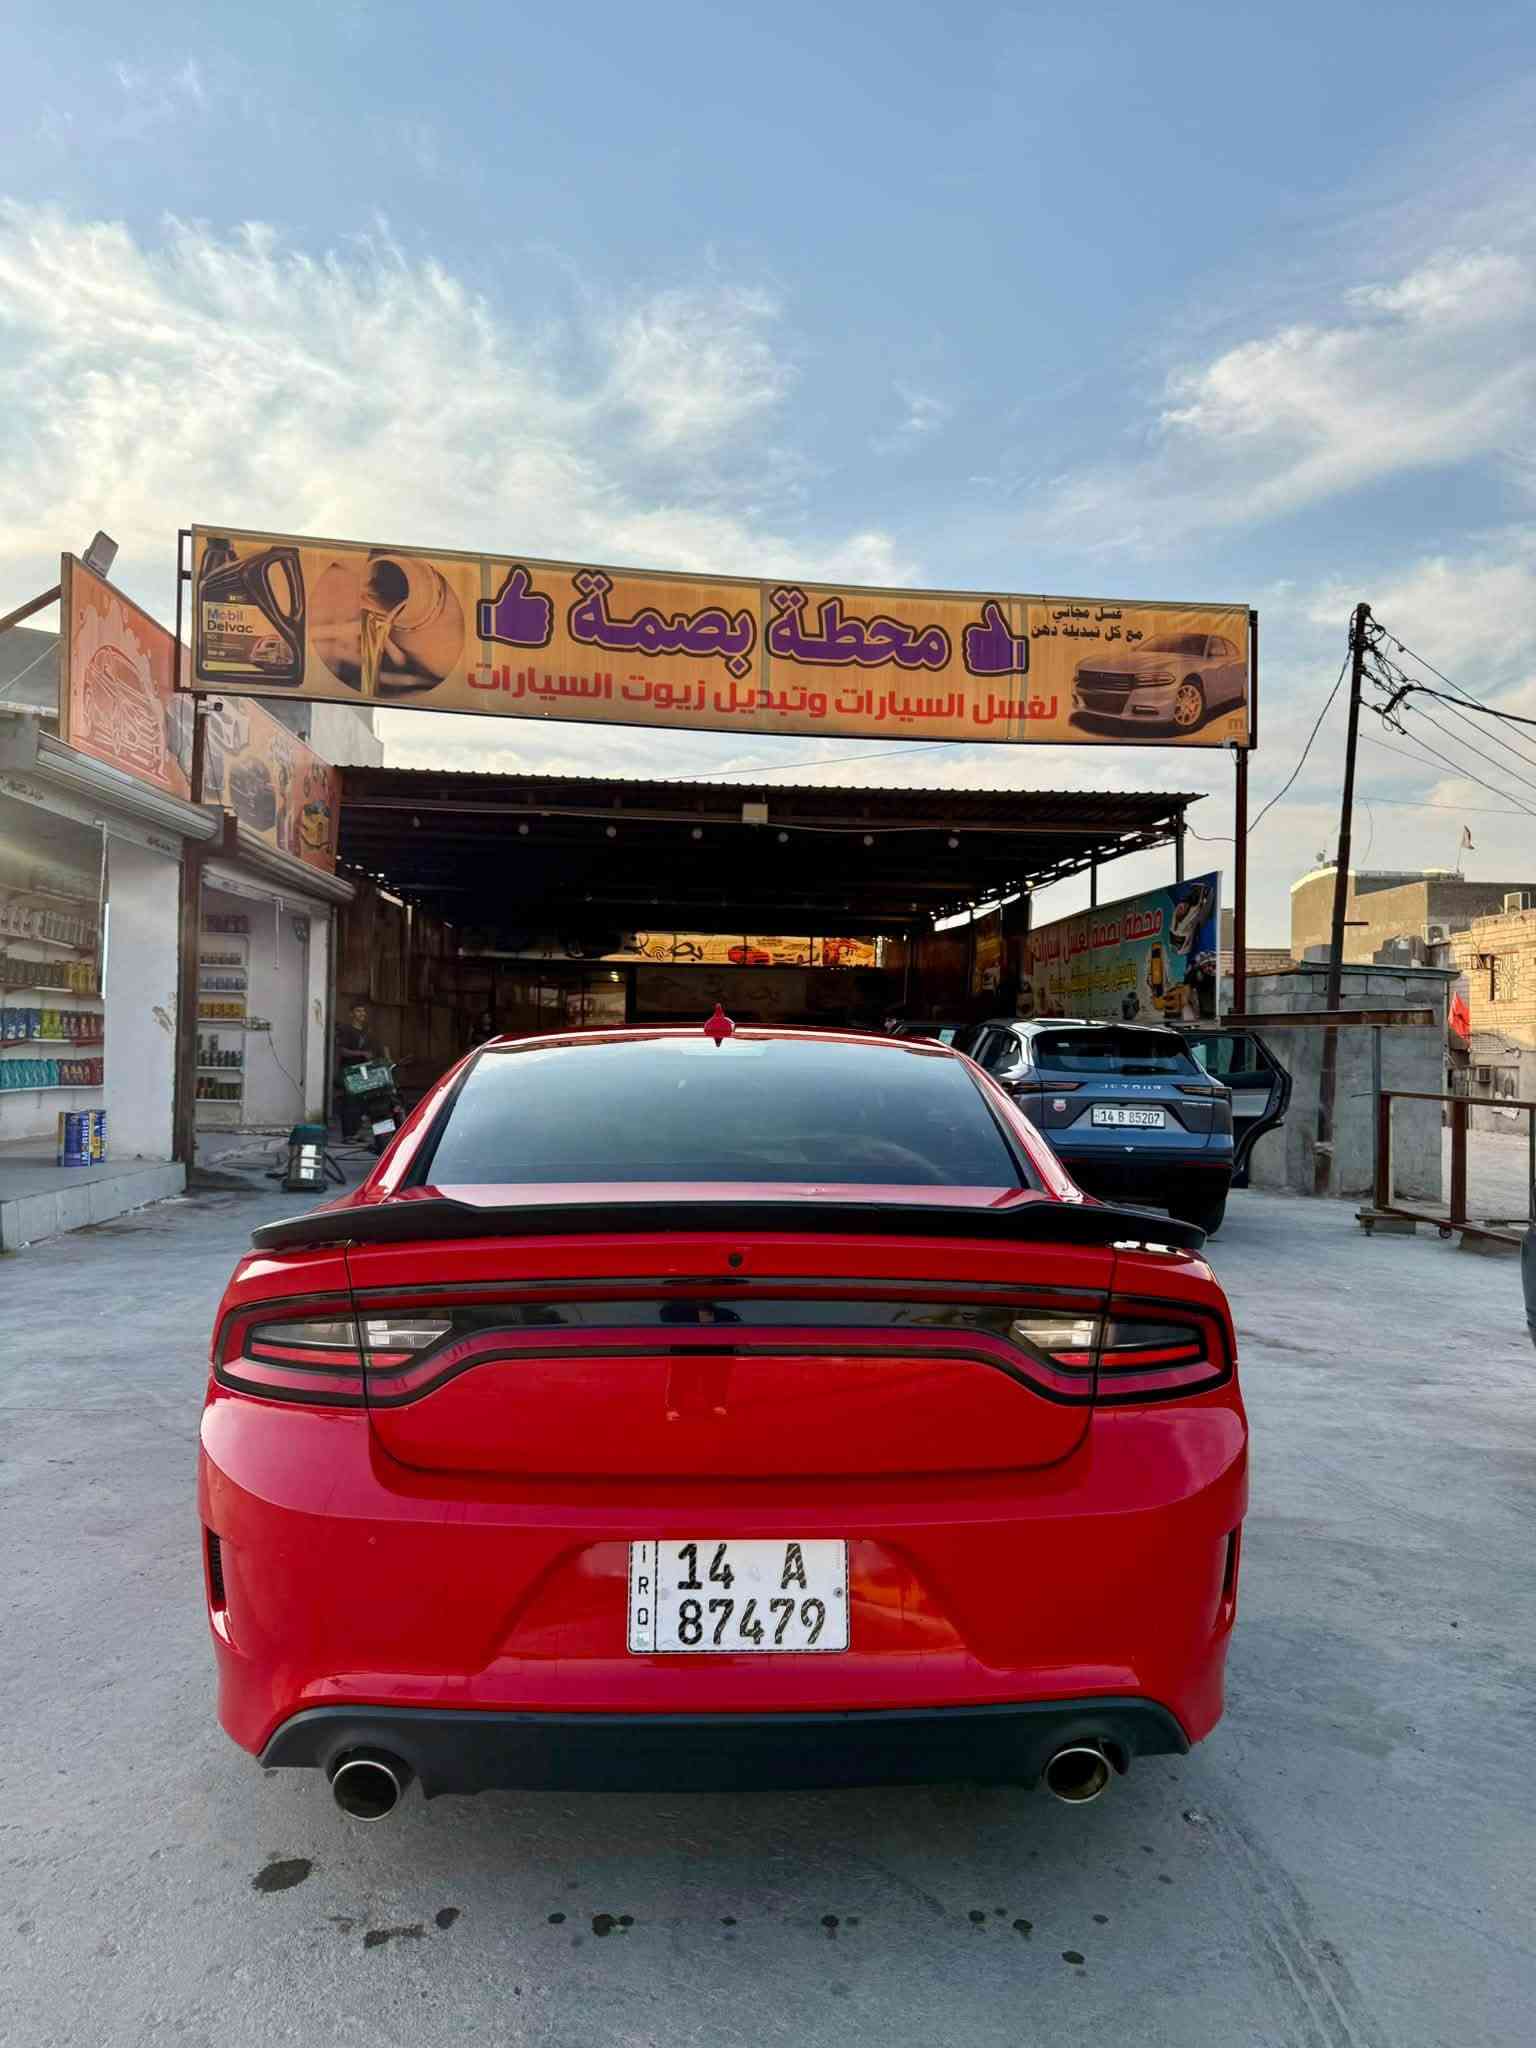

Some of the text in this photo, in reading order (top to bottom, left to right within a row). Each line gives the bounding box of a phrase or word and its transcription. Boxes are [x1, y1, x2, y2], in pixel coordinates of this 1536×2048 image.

[207, 607, 243, 621] Mobil
[1052, 604, 1122, 623] غسل مجاني
[207, 620, 254, 633] Delvac
[568, 569, 951, 679] محطة بصمة
[1104, 624, 1122, 641] كل
[1125, 628, 1143, 642] مع
[467, 662, 1058, 725] لغسل السيارات وتبديل زيوت السيارات
[1101, 1111, 1114, 1122] 14
[677, 1543, 807, 1590] 14 A
[677, 1598, 826, 1646] 87479
